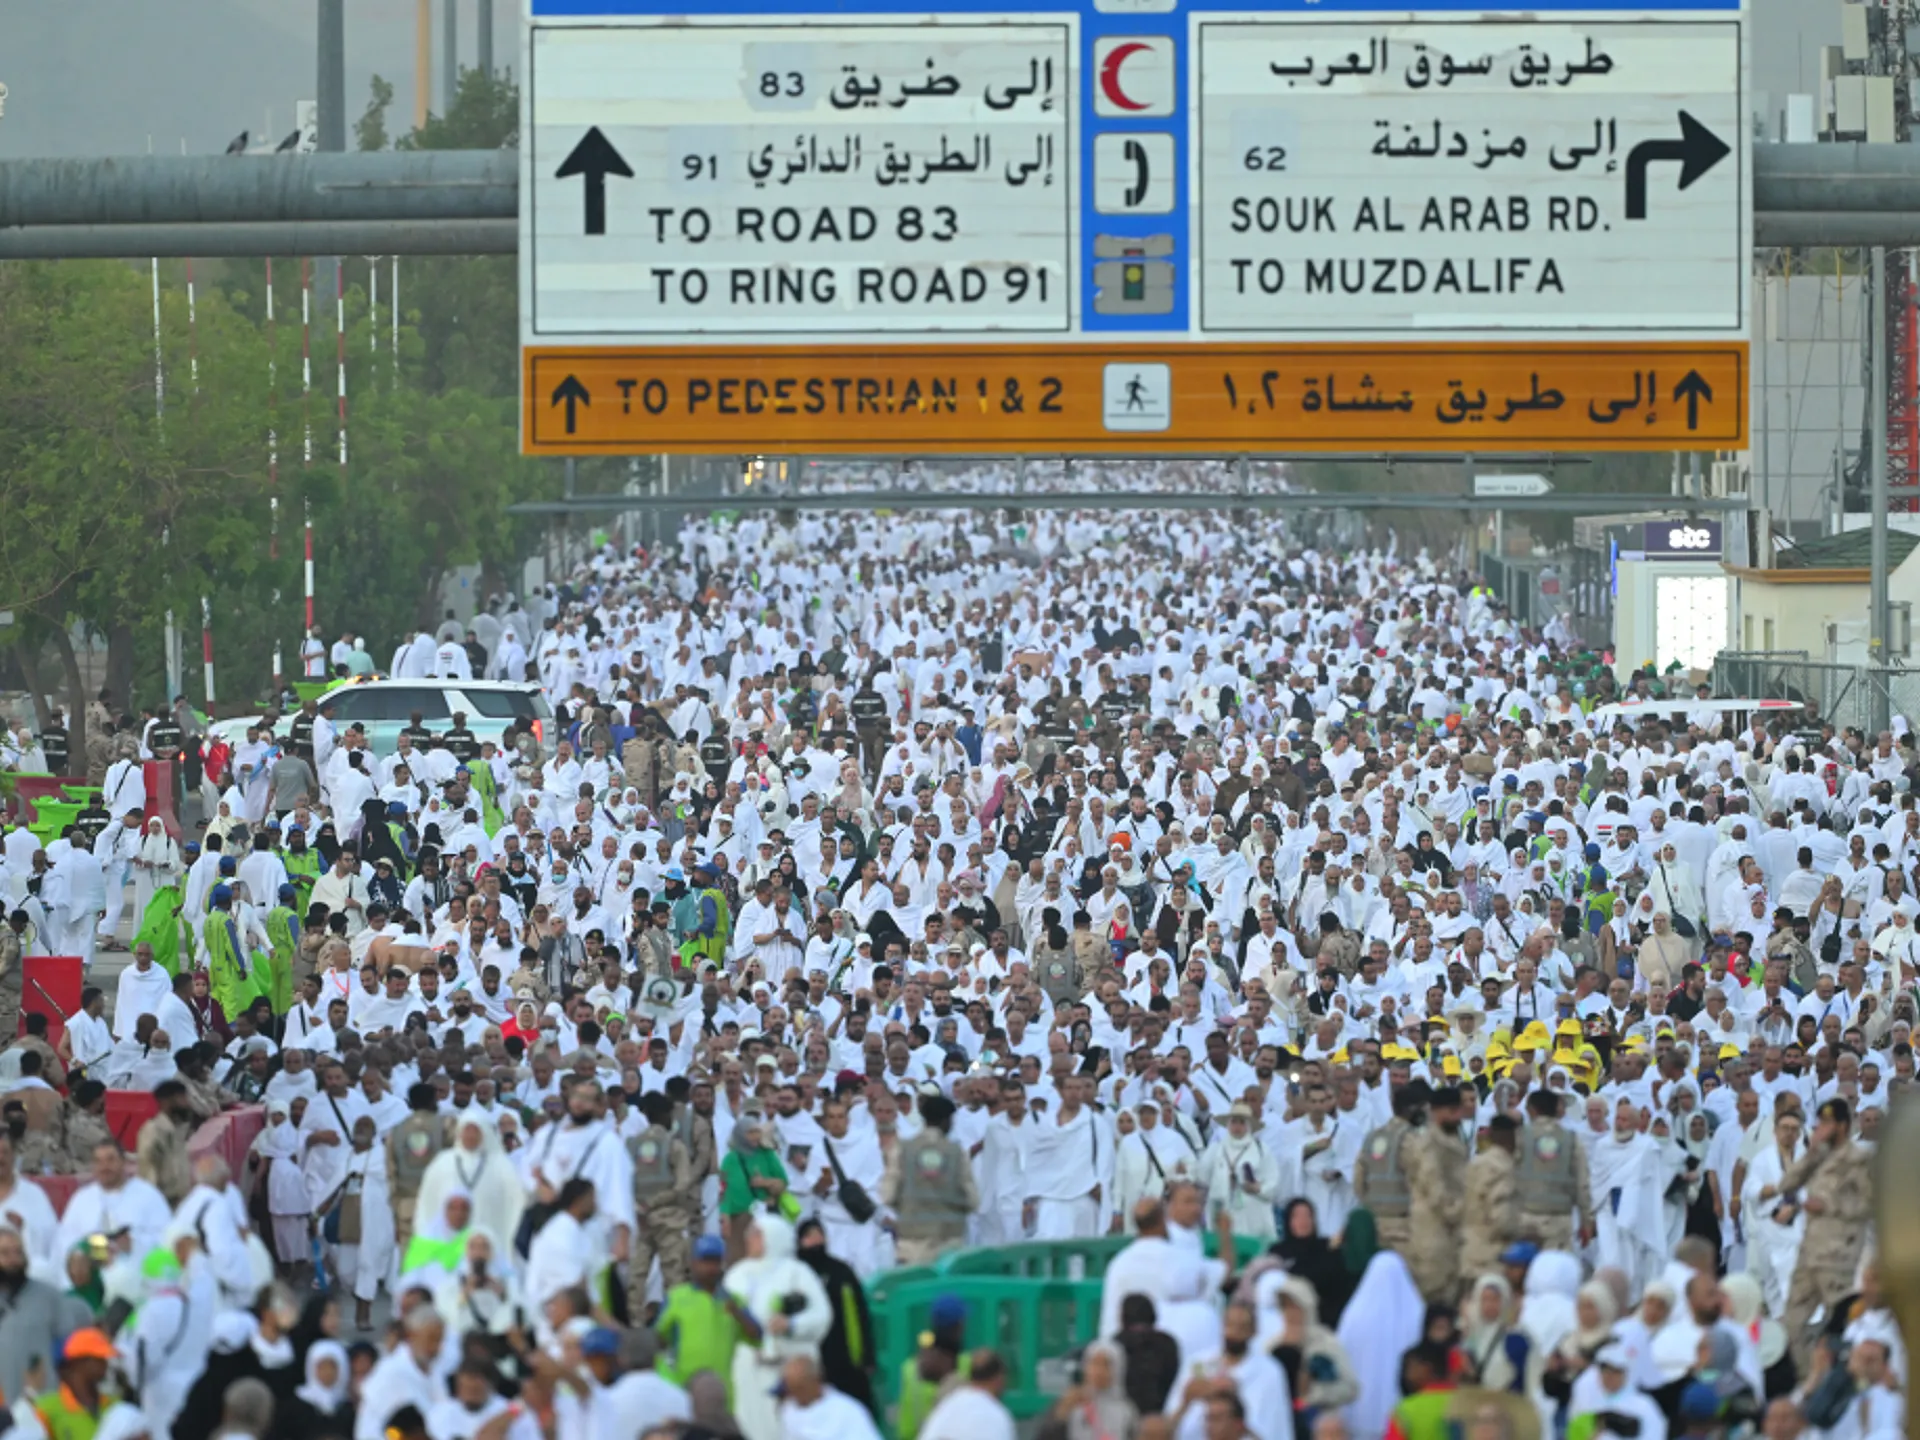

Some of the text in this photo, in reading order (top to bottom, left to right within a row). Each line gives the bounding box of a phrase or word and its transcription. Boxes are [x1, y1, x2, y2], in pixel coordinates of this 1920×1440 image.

[1270, 37, 1614, 89] طريق سوق العرب
[760, 72, 804, 97] 83
[984, 58, 1052, 111] إلى
[683, 135, 1052, 188] إلى الطريق الدائري 91
[1244, 118, 1616, 173] إلى مزدلفة 62
[648, 206, 958, 243] TO ROAD 83
[1231, 196, 1610, 233] SOUK AL ARAB RD.
[651, 266, 1047, 304] TO RING ROAD 91
[1230, 258, 1564, 294] TO MUZDALIFA
[615, 378, 668, 415] TO
[687, 377, 957, 415] PEDESTRIAN
[1000, 377, 1024, 414] &
[1039, 376, 1063, 413] 2
[1301, 373, 1414, 413] مشاة
[1435, 372, 1566, 424] طريق
[1588, 369, 1657, 425] إلى
